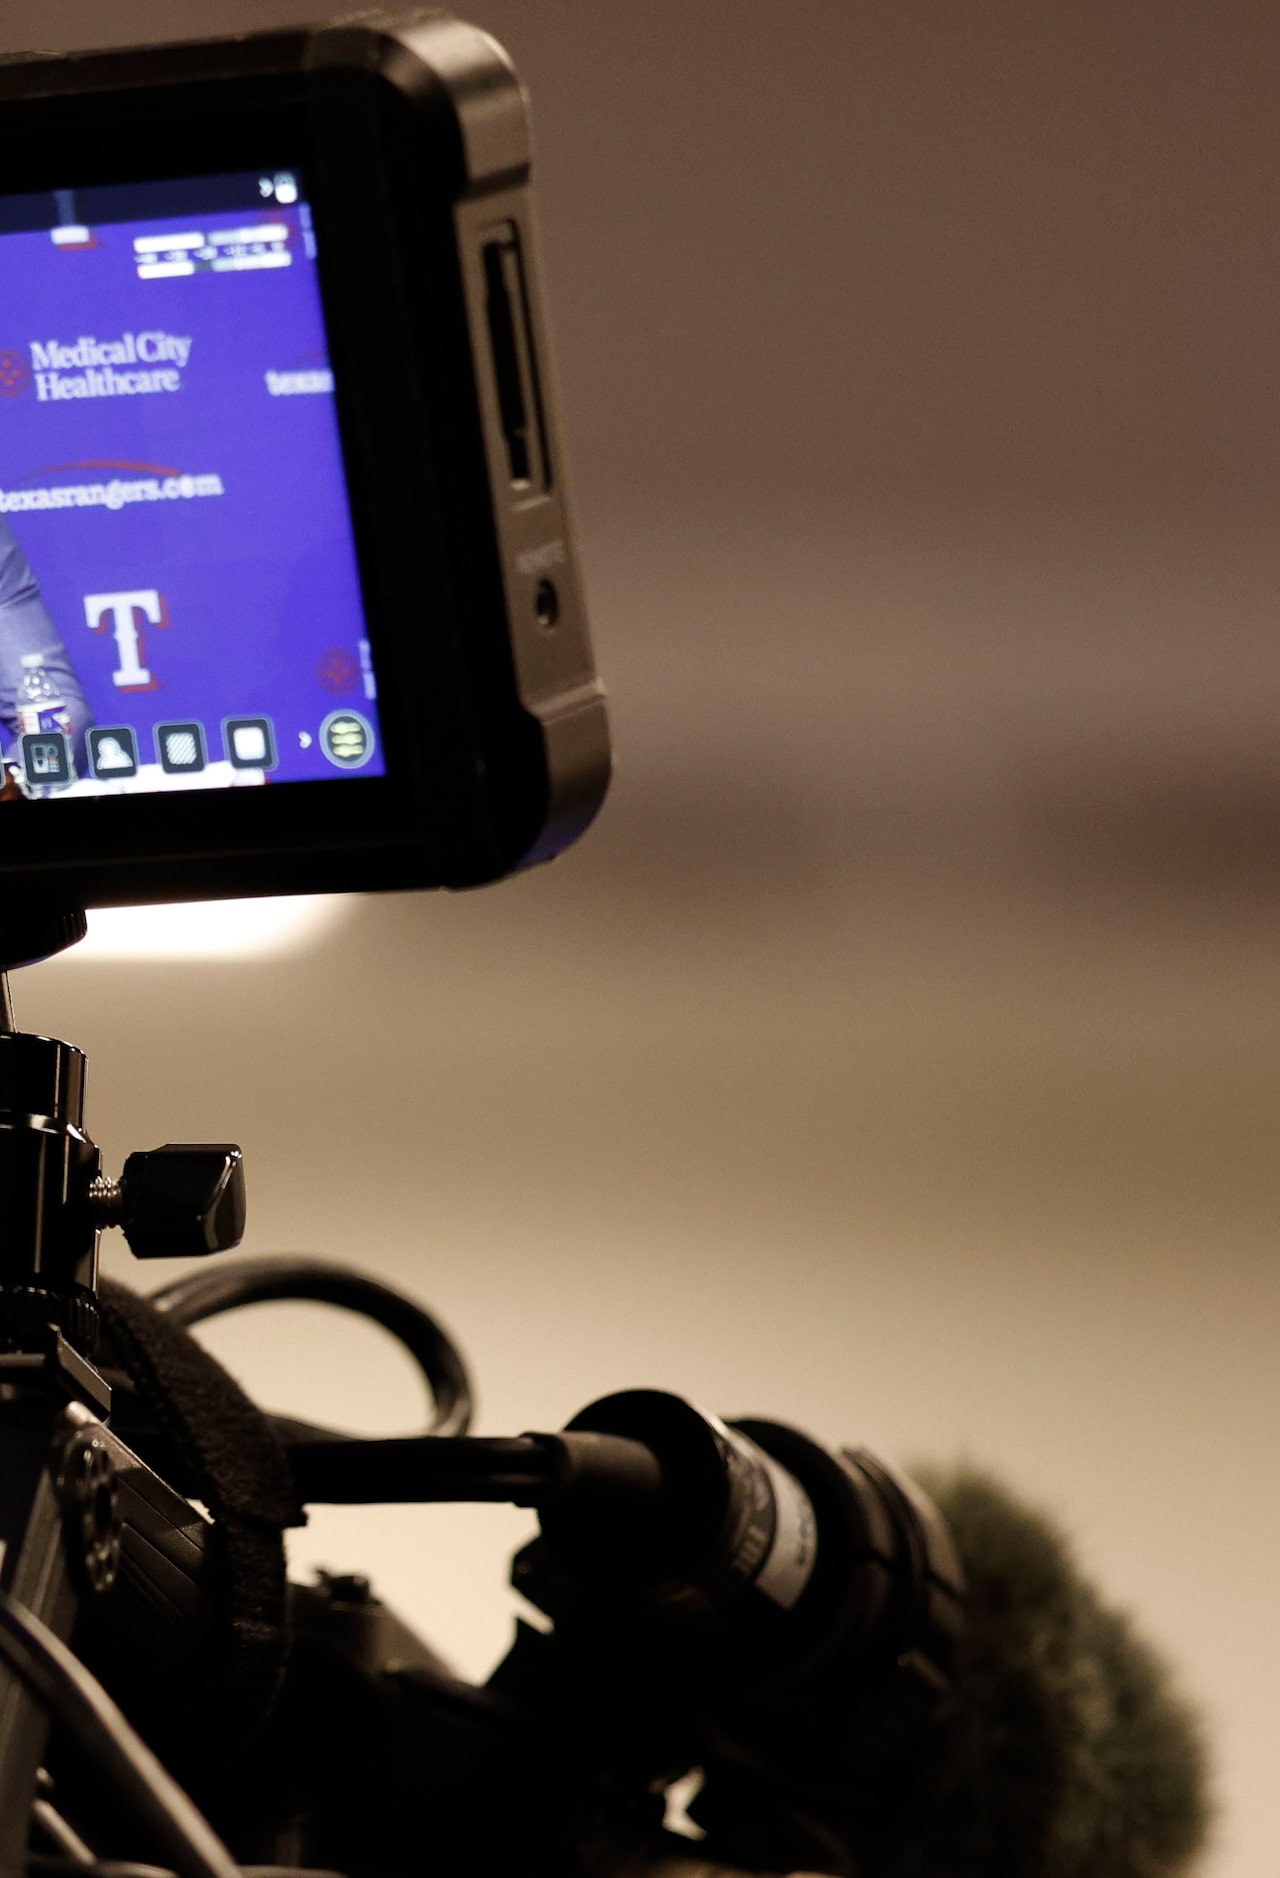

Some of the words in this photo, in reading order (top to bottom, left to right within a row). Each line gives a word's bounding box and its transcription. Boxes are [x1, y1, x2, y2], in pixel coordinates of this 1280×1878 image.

[29, 333, 137, 371] Medical
[136, 331, 191, 366] City
[34, 367, 181, 401] Healthcare
[84, 590, 169, 692] T
